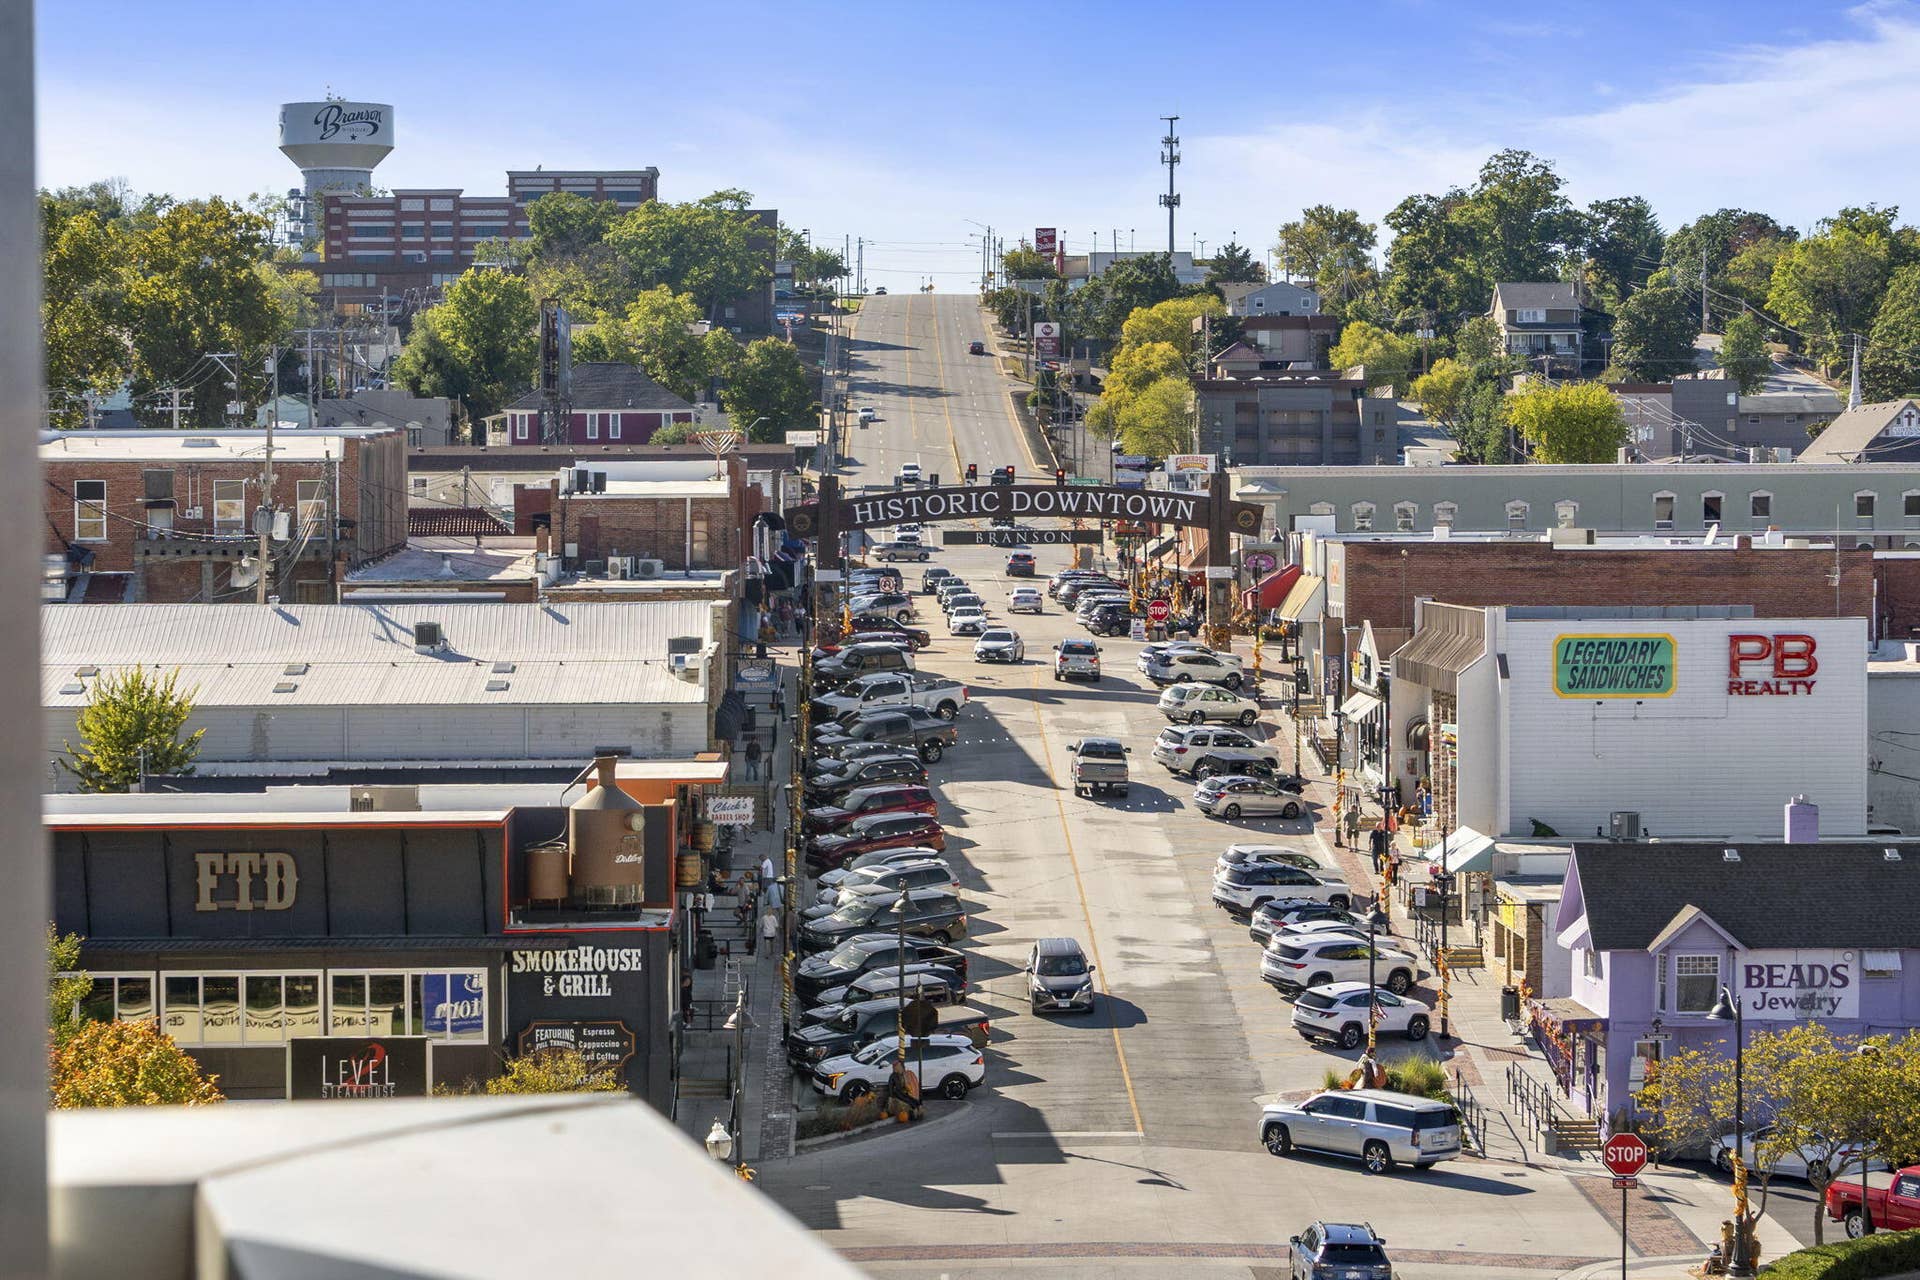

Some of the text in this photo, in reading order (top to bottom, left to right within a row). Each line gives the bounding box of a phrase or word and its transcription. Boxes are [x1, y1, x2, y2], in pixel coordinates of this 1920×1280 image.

[314, 104, 382, 140] Branson
[853, 491, 1196, 524] HISTORIC DOWNTOWN
[975, 531, 1073, 544] BRANSON
[1150, 606, 1167, 615] STOP
[1561, 640, 1662, 665] LEGENDARY
[1727, 634, 1819, 679] PB
[1567, 665, 1666, 690] SANDWICHES
[1727, 680, 1817, 696] REALTY
[712, 800, 748, 813] Chick's
[711, 813, 750, 821] BARBER SHOP
[195, 852, 299, 911] FTD
[543, 974, 612, 997] & GRILL
[1743, 963, 1850, 989] BEADS
[1752, 991, 1843, 1016] Jewelry
[535, 1028, 575, 1043] FEATURING
[583, 1028, 615, 1037] Espresso
[578, 1040, 620, 1049] Cappuccino
[322, 1055, 395, 1086] LEVEL
[322, 1086, 395, 1098] STEAKHOUSE
[1607, 1146, 1644, 1162] STOP
